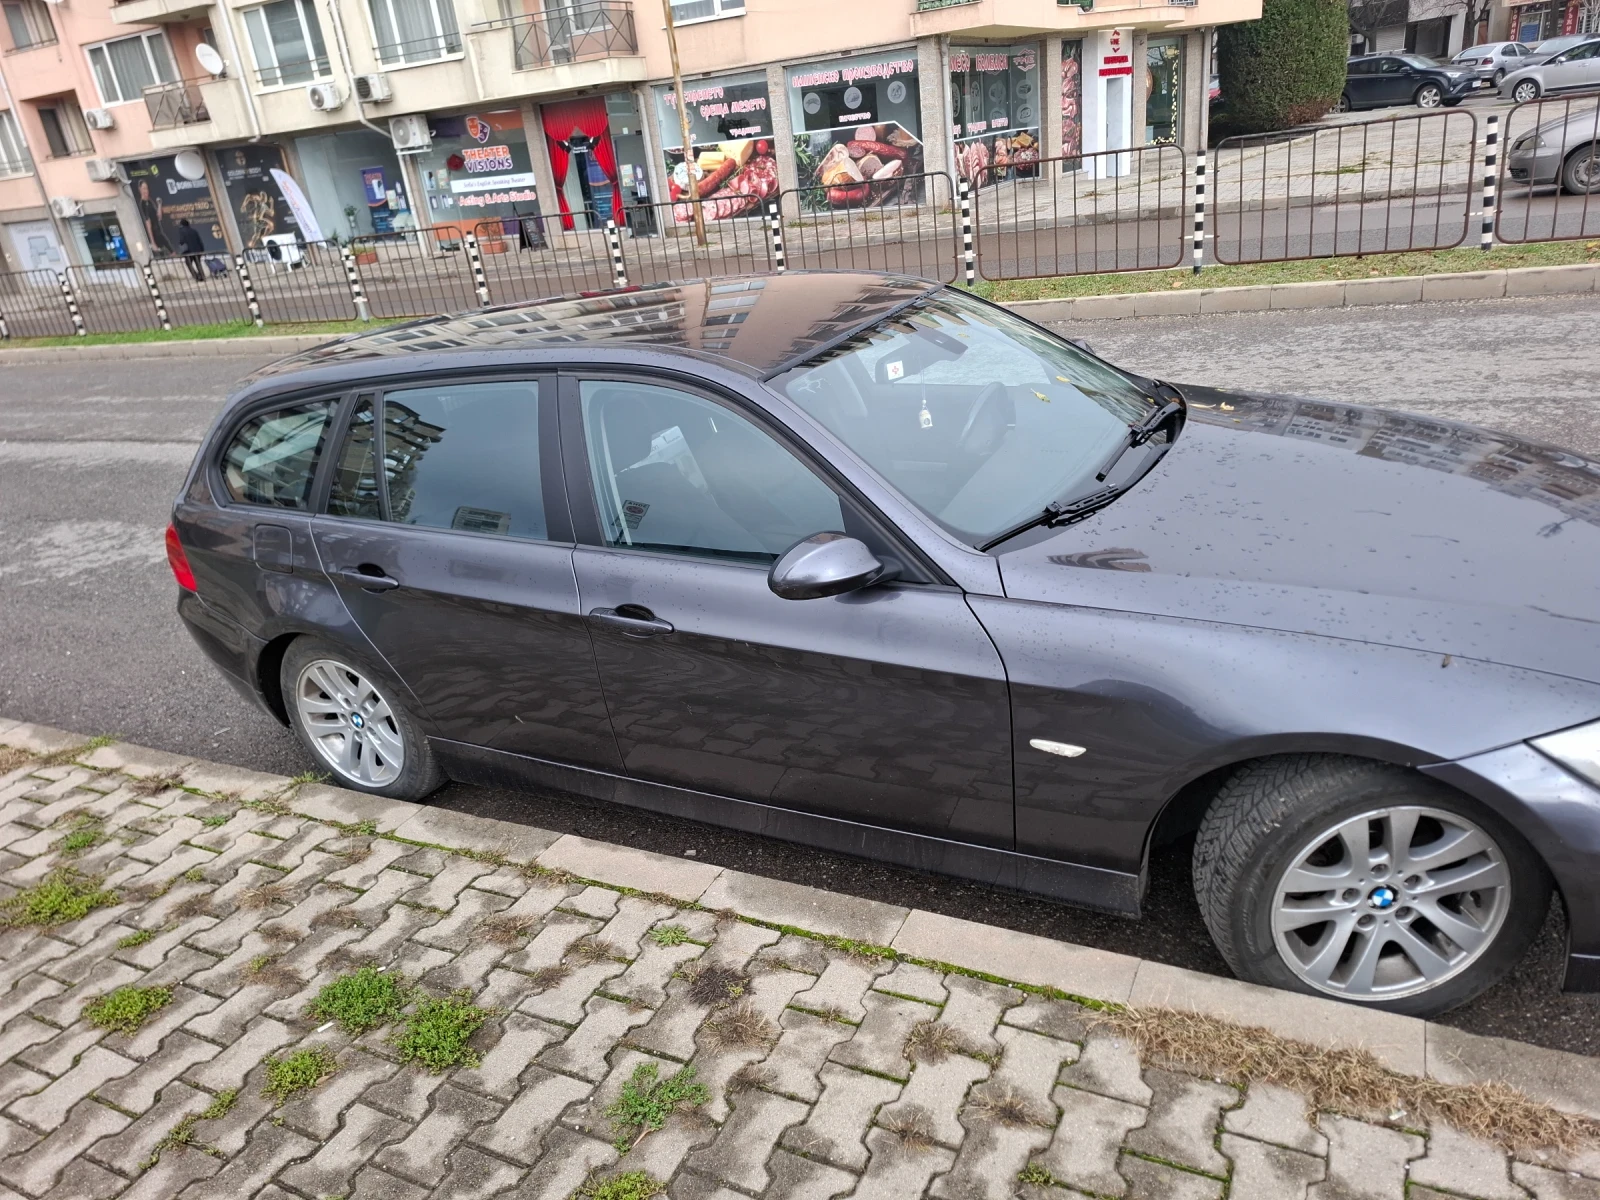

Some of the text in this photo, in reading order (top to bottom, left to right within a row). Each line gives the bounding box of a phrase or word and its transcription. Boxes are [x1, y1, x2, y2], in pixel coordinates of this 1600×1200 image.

[462, 145, 510, 160] THEATER
[464, 157, 513, 173] VISIONS
[459, 194, 485, 207] Acting
[492, 192, 509, 204] Arts
[509, 189, 536, 202] Studio
